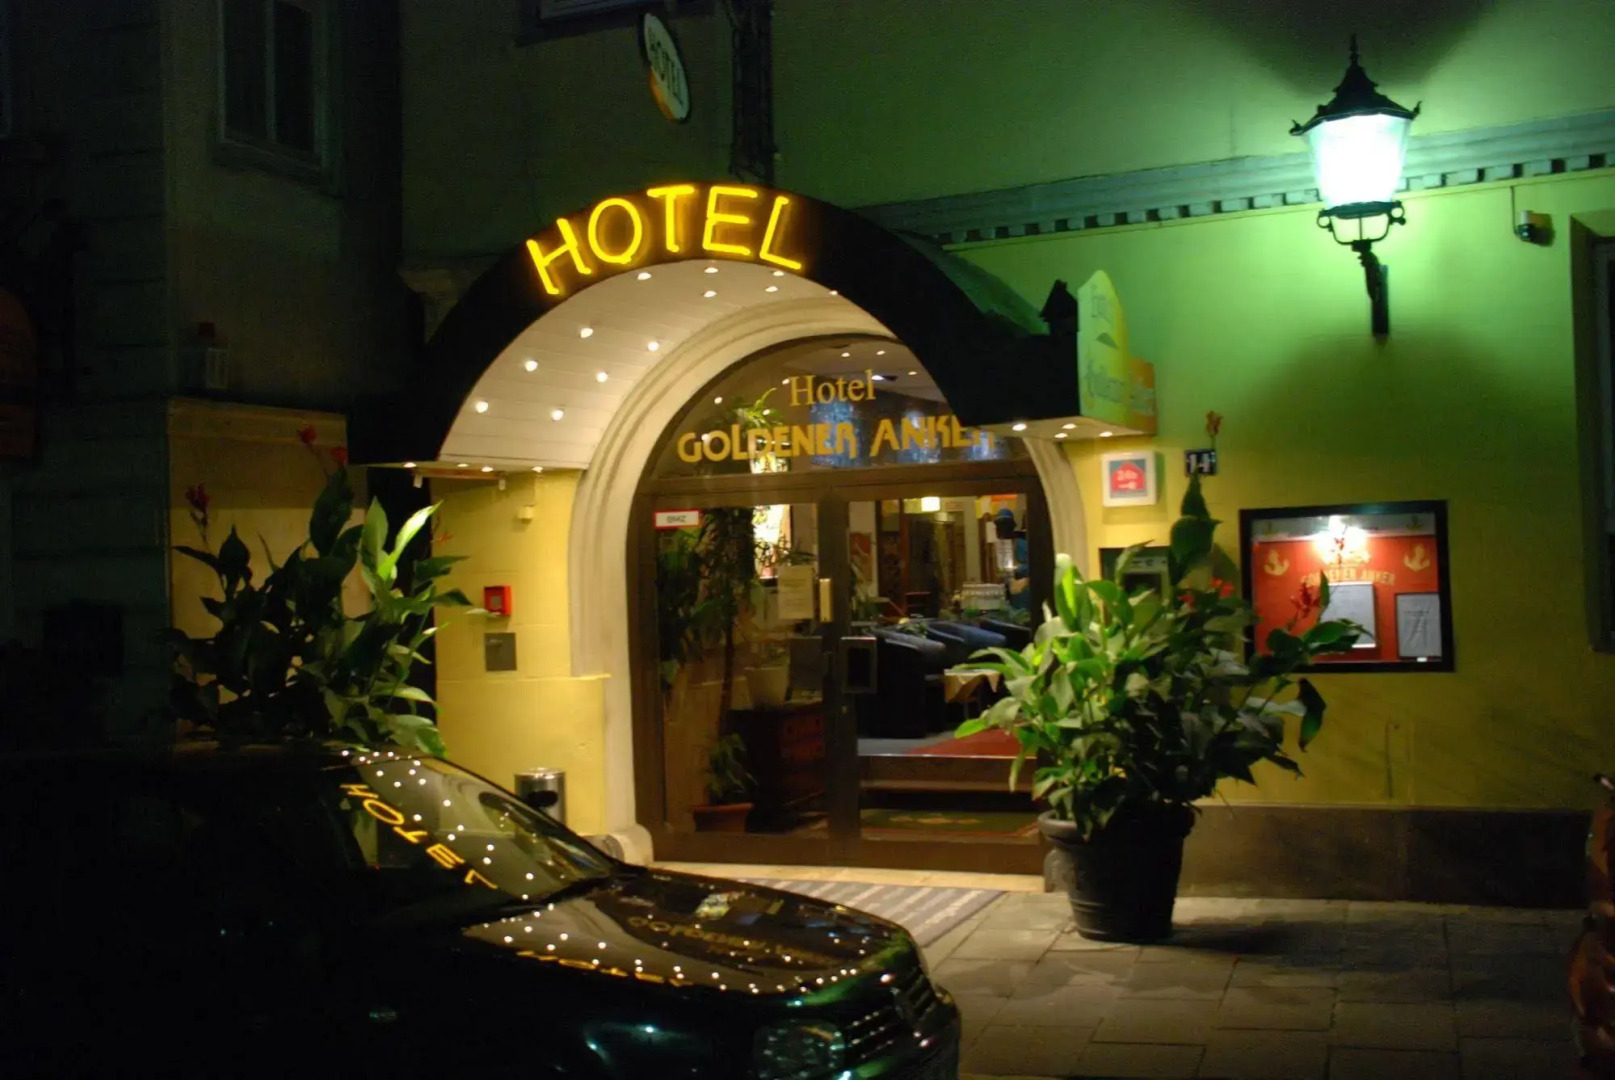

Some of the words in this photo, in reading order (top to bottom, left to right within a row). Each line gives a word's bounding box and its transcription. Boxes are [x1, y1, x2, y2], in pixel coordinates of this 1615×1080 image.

[525, 183, 803, 296] HOTEL
[789, 369, 876, 406] Hotel
[677, 422, 857, 464] GOLDENER
